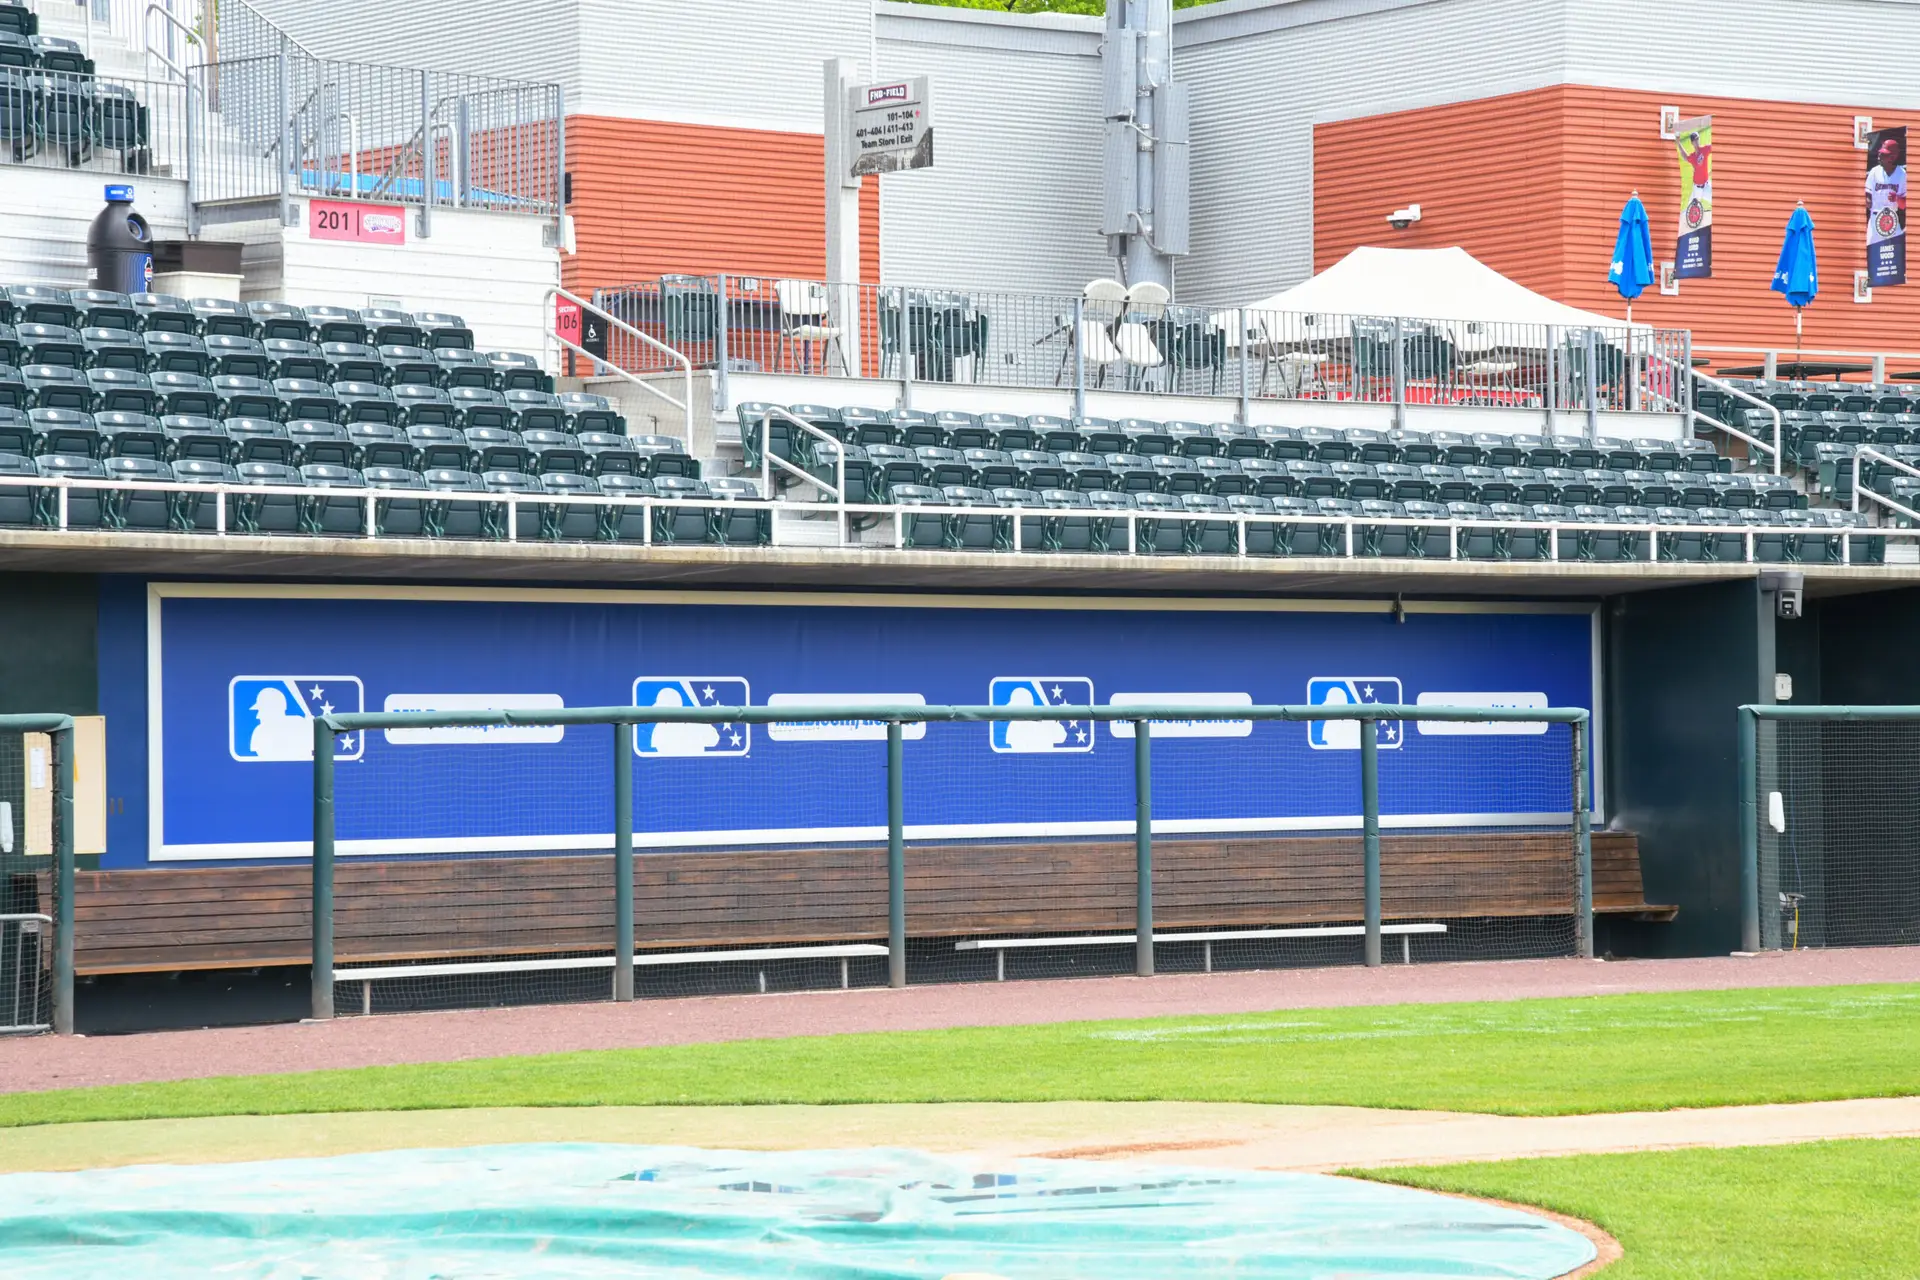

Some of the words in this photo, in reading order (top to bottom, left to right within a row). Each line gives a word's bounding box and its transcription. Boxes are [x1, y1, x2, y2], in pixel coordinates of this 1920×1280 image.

[886, 87, 905, 97] FIELD
[861, 140, 878, 149] Team
[878, 138, 895, 147] Store
[900, 134, 913, 144] Exit
[318, 210, 348, 230] 201
[557, 314, 578, 330] 106
